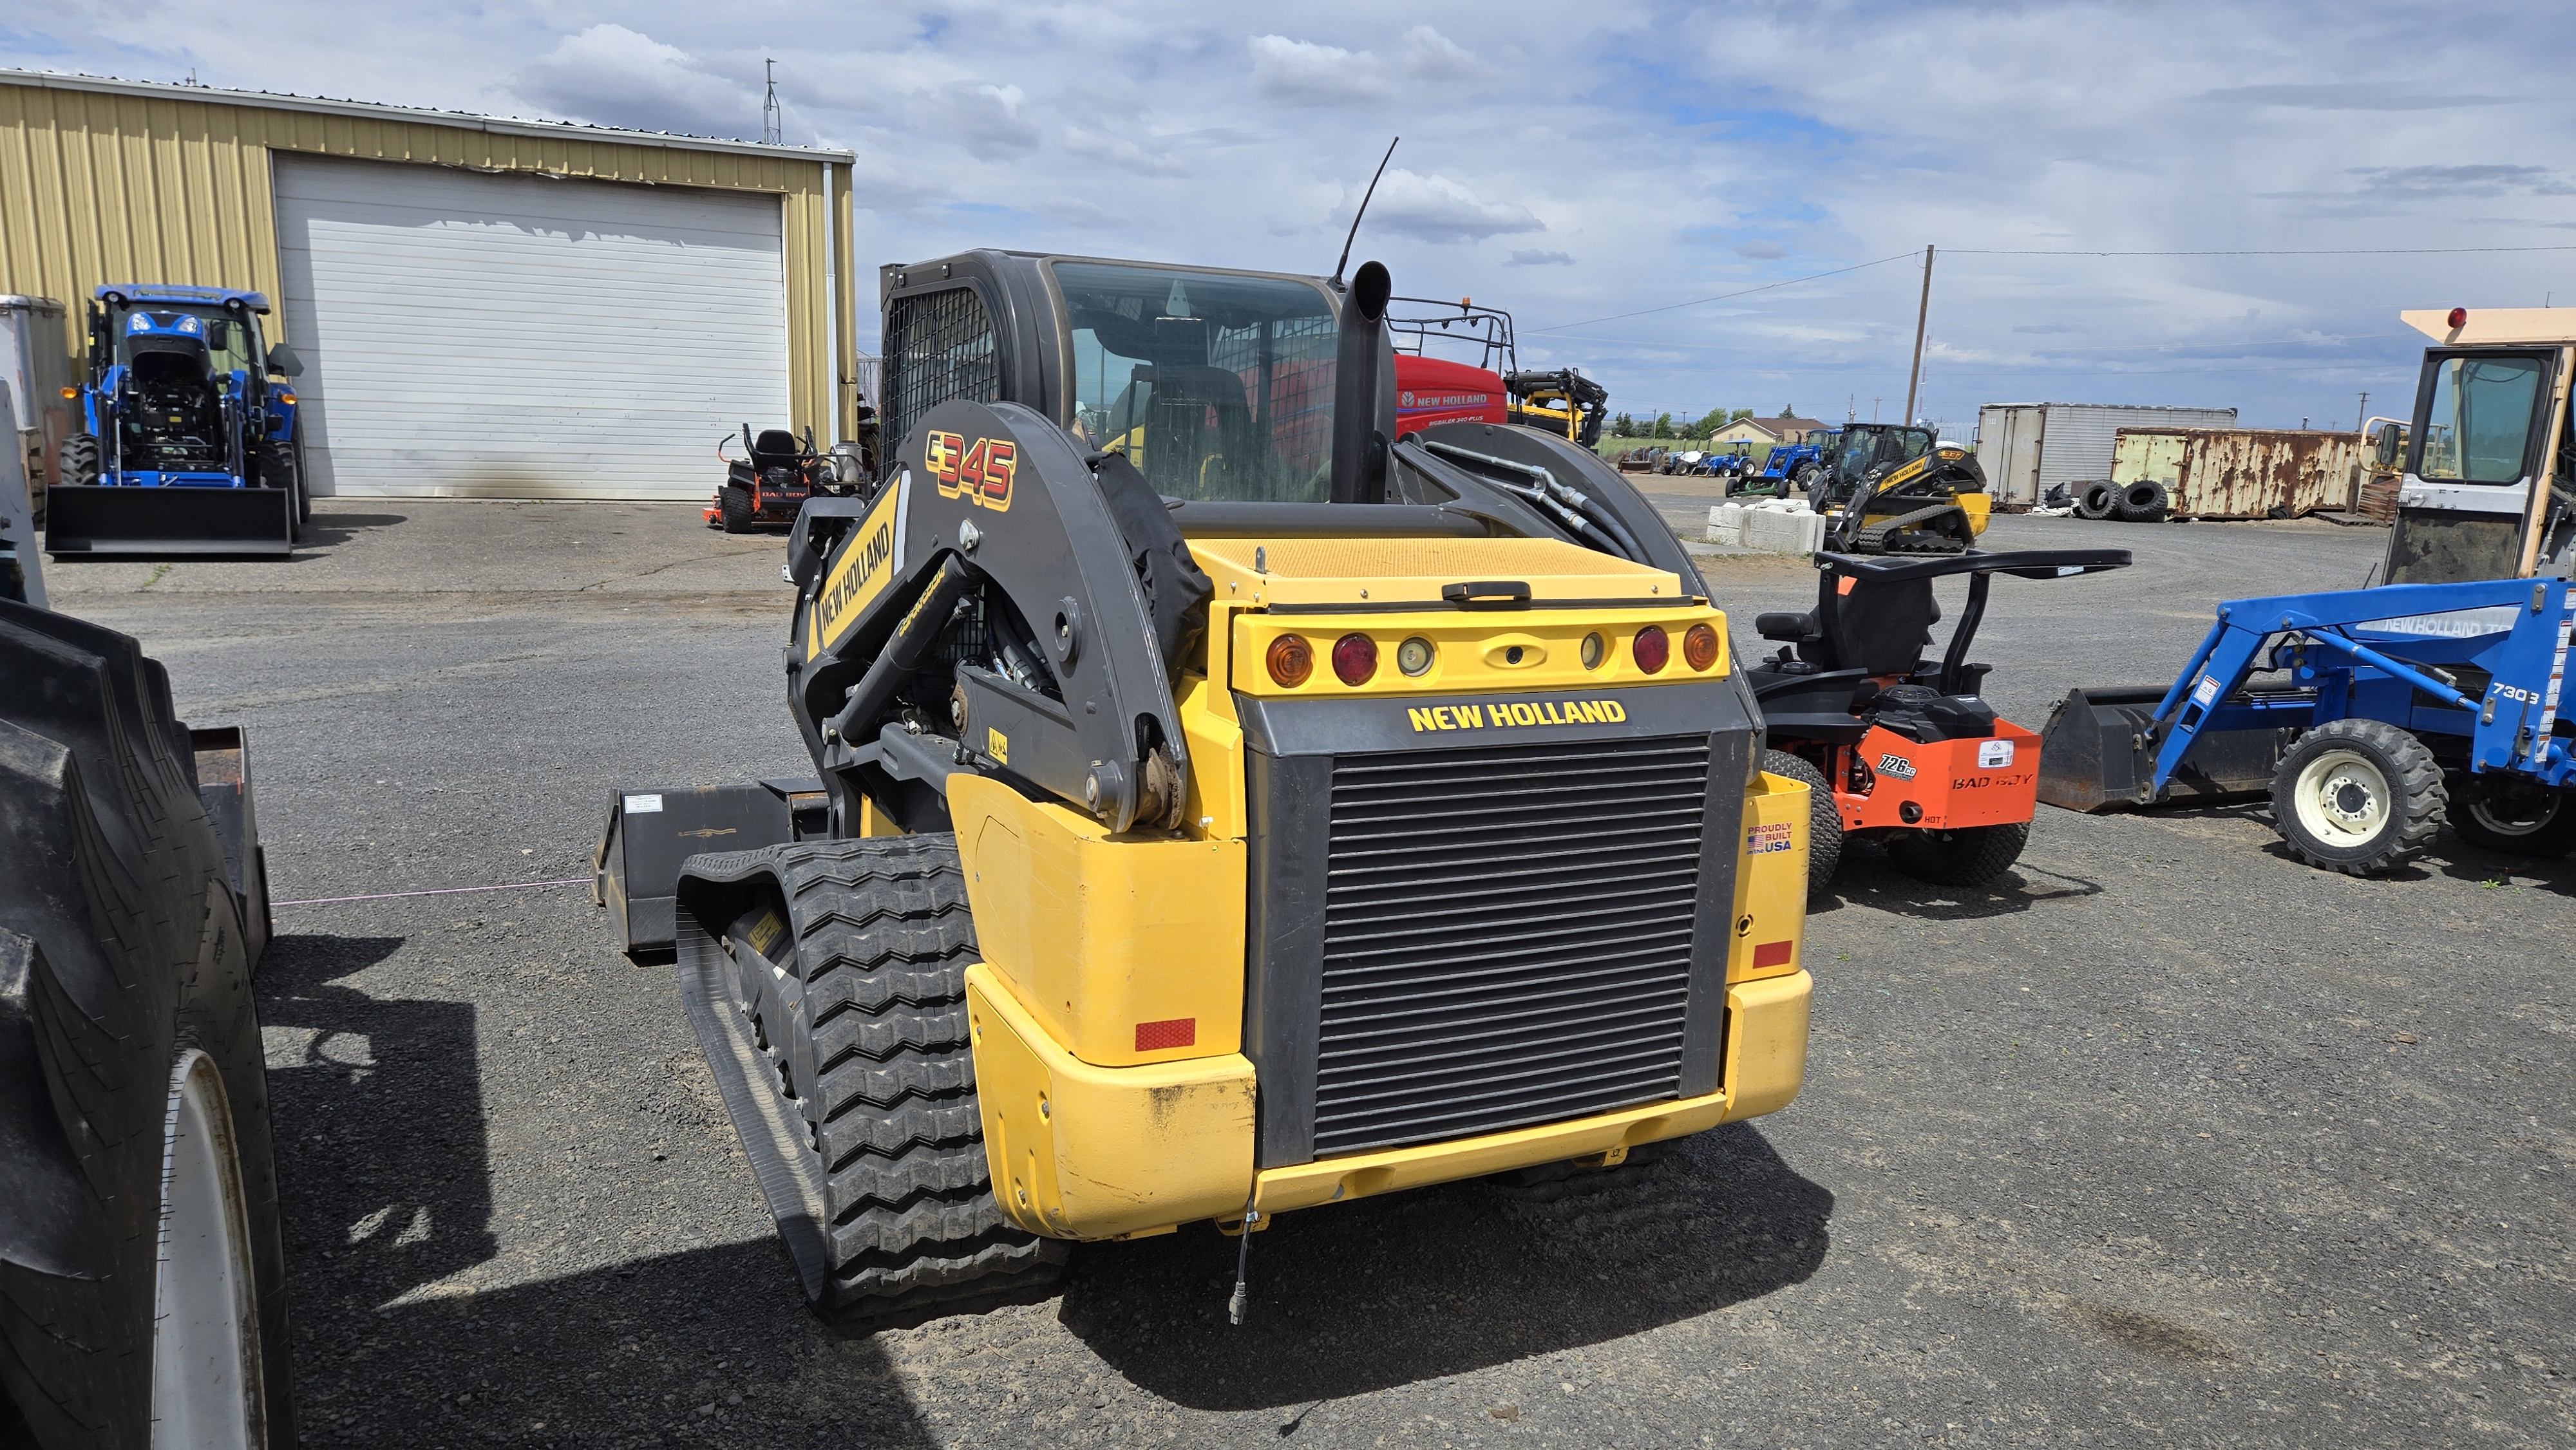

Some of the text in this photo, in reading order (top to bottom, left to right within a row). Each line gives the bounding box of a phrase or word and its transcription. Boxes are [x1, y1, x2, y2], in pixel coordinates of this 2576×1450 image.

[1417, 394, 1487, 407] NEW HOLLAND
[926, 431, 1016, 510] C345
[1886, 474, 1899, 484] NEW
[1899, 462, 1922, 478] HOLLAND
[821, 521, 889, 632] NEW HOLLAND
[2385, 618, 2415, 633] NEW
[2416, 618, 2481, 637] HOLLAND
[2492, 682, 2539, 705] 7303
[1407, 701, 1627, 731] NEW HOLLAND
[1953, 774, 2034, 789] BAD BOY
[1748, 823, 1792, 834] PROUDLY
[1924, 816, 1941, 824] HOT
[1765, 832, 1792, 842] BUILT
[1765, 840, 1792, 852] USA
